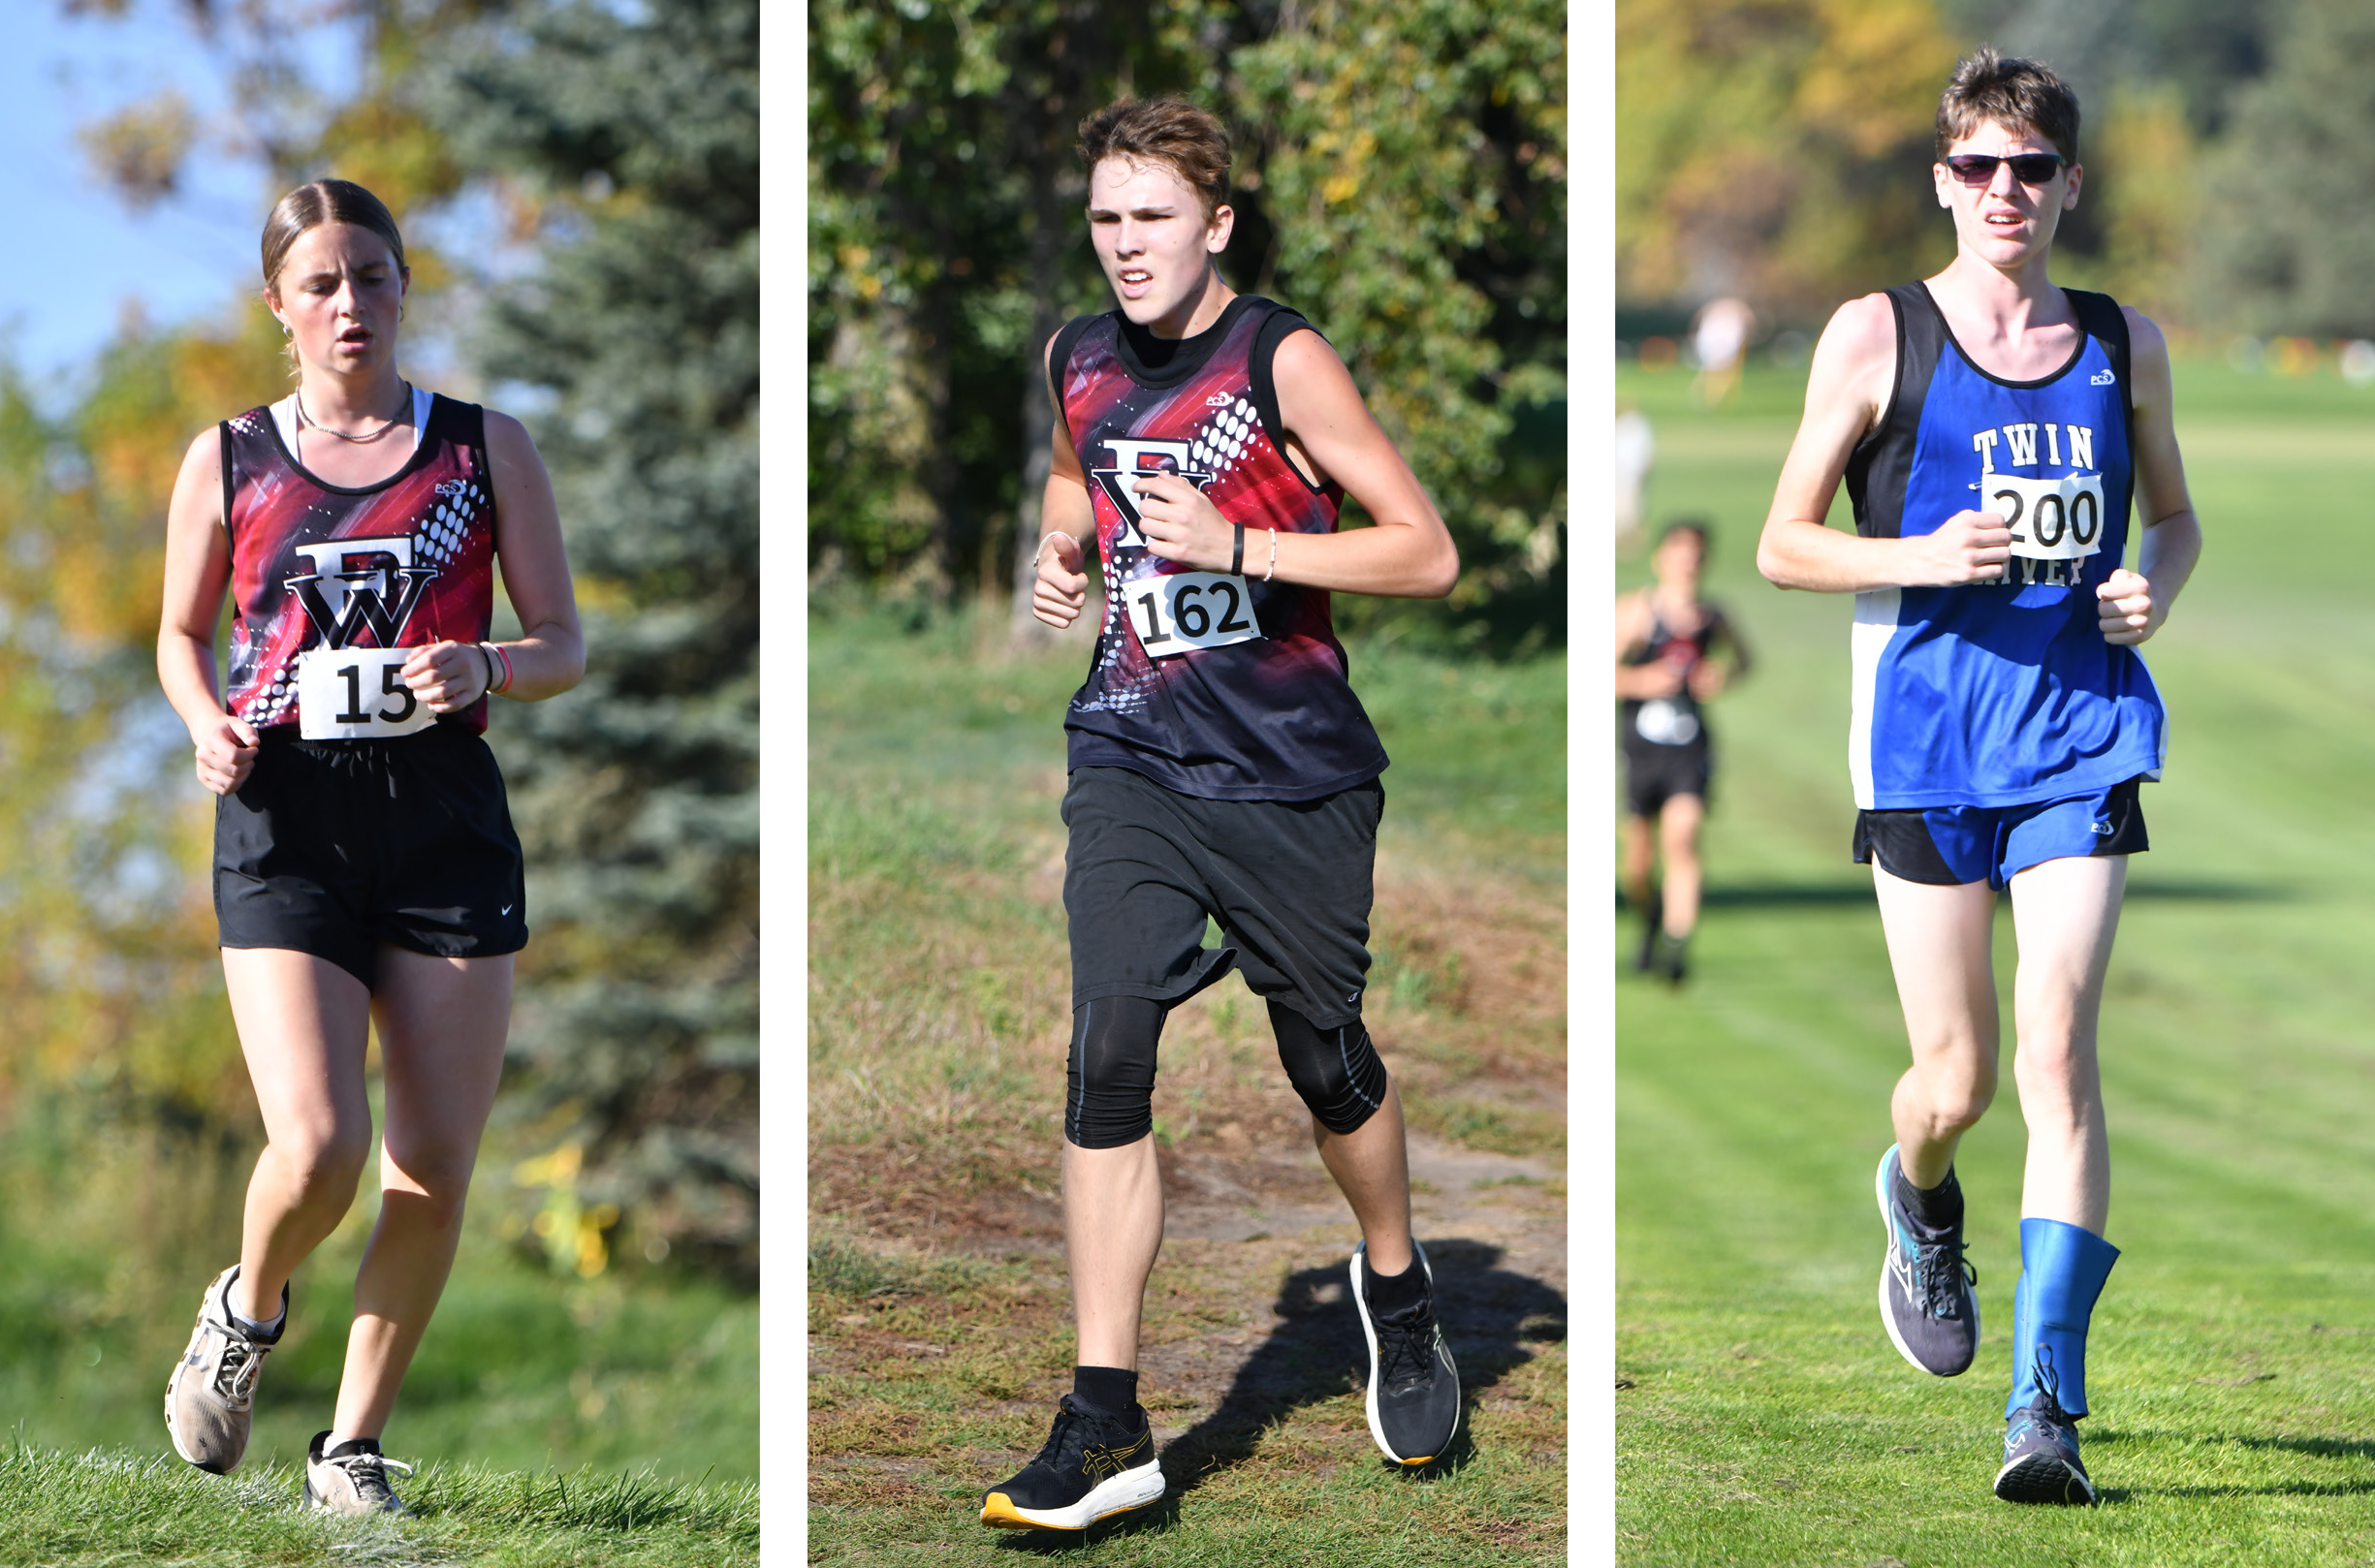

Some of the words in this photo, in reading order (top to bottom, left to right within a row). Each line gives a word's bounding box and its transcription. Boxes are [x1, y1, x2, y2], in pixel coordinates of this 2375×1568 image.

[2091, 373, 2111, 385] PCS
[1206, 394, 1227, 406] PCS
[1973, 423, 2094, 473] TWIN
[435, 482, 459, 493] PCS
[1993, 489, 2098, 547] 200
[1973, 556, 2086, 586] IVER
[1137, 581, 1251, 645] 162
[335, 663, 418, 724] 15
